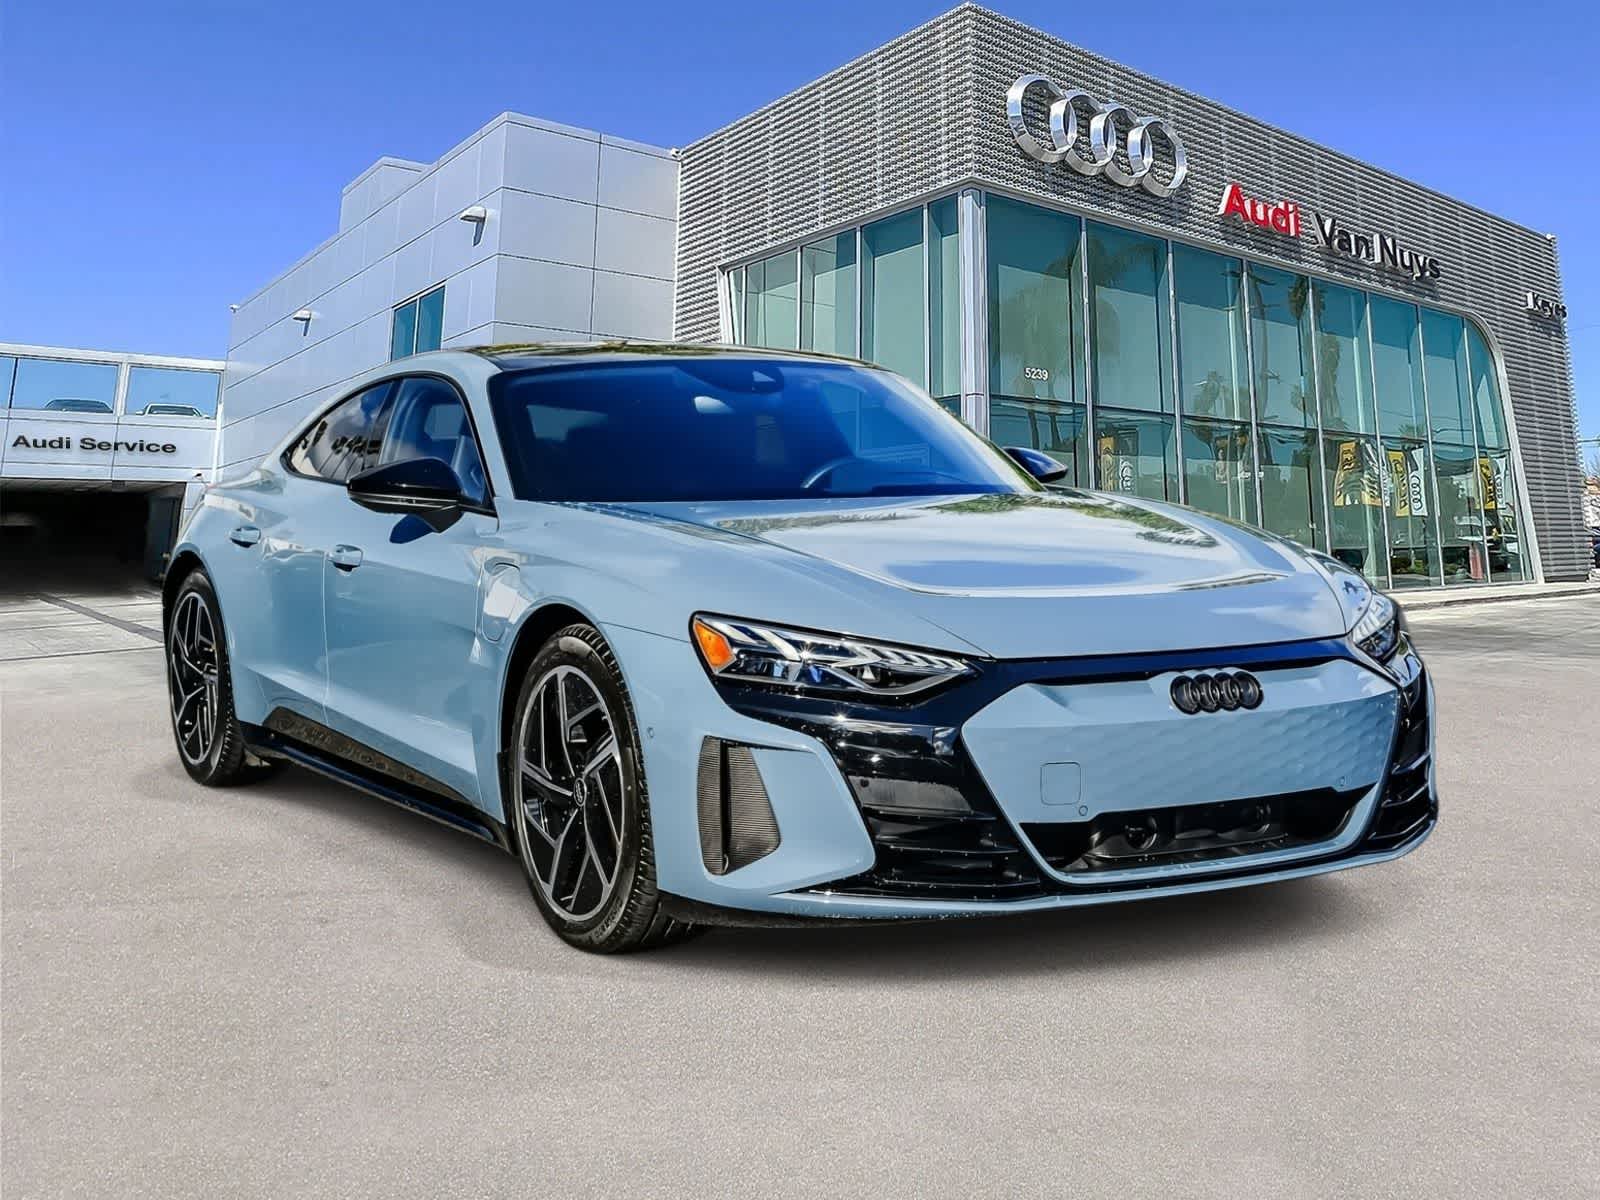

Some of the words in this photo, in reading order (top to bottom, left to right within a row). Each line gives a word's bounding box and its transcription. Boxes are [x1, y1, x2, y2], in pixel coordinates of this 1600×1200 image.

[1218, 182, 1301, 237] Audi
[1312, 212, 1370, 258] Van
[1374, 233, 1441, 280] Nuys
[1024, 367, 1049, 381] 5239
[12, 435, 71, 449] Audi
[79, 437, 177, 453] Service
